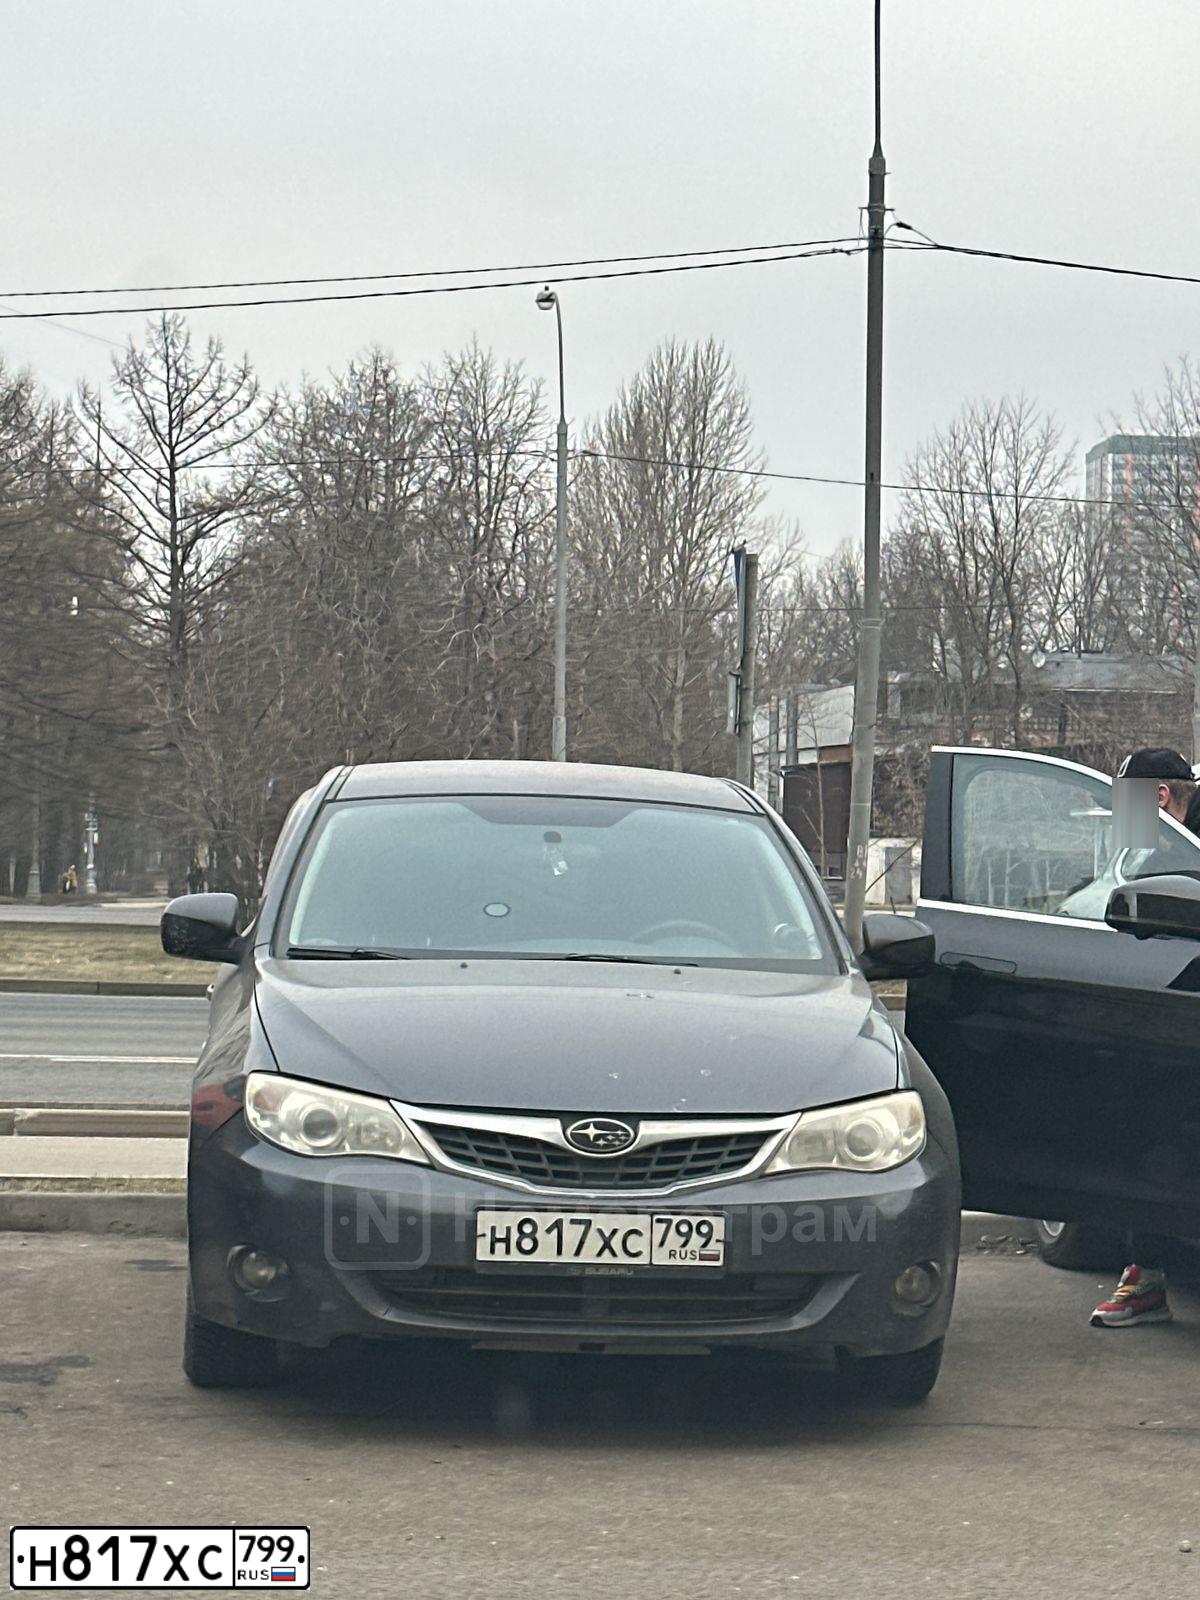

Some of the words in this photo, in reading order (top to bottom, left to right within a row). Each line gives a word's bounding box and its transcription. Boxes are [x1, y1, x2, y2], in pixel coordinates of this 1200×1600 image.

[489, 1217, 644, 1258] Н817ХС
[655, 1218, 715, 1249] 799
[668, 1249, 698, 1261] RUS
